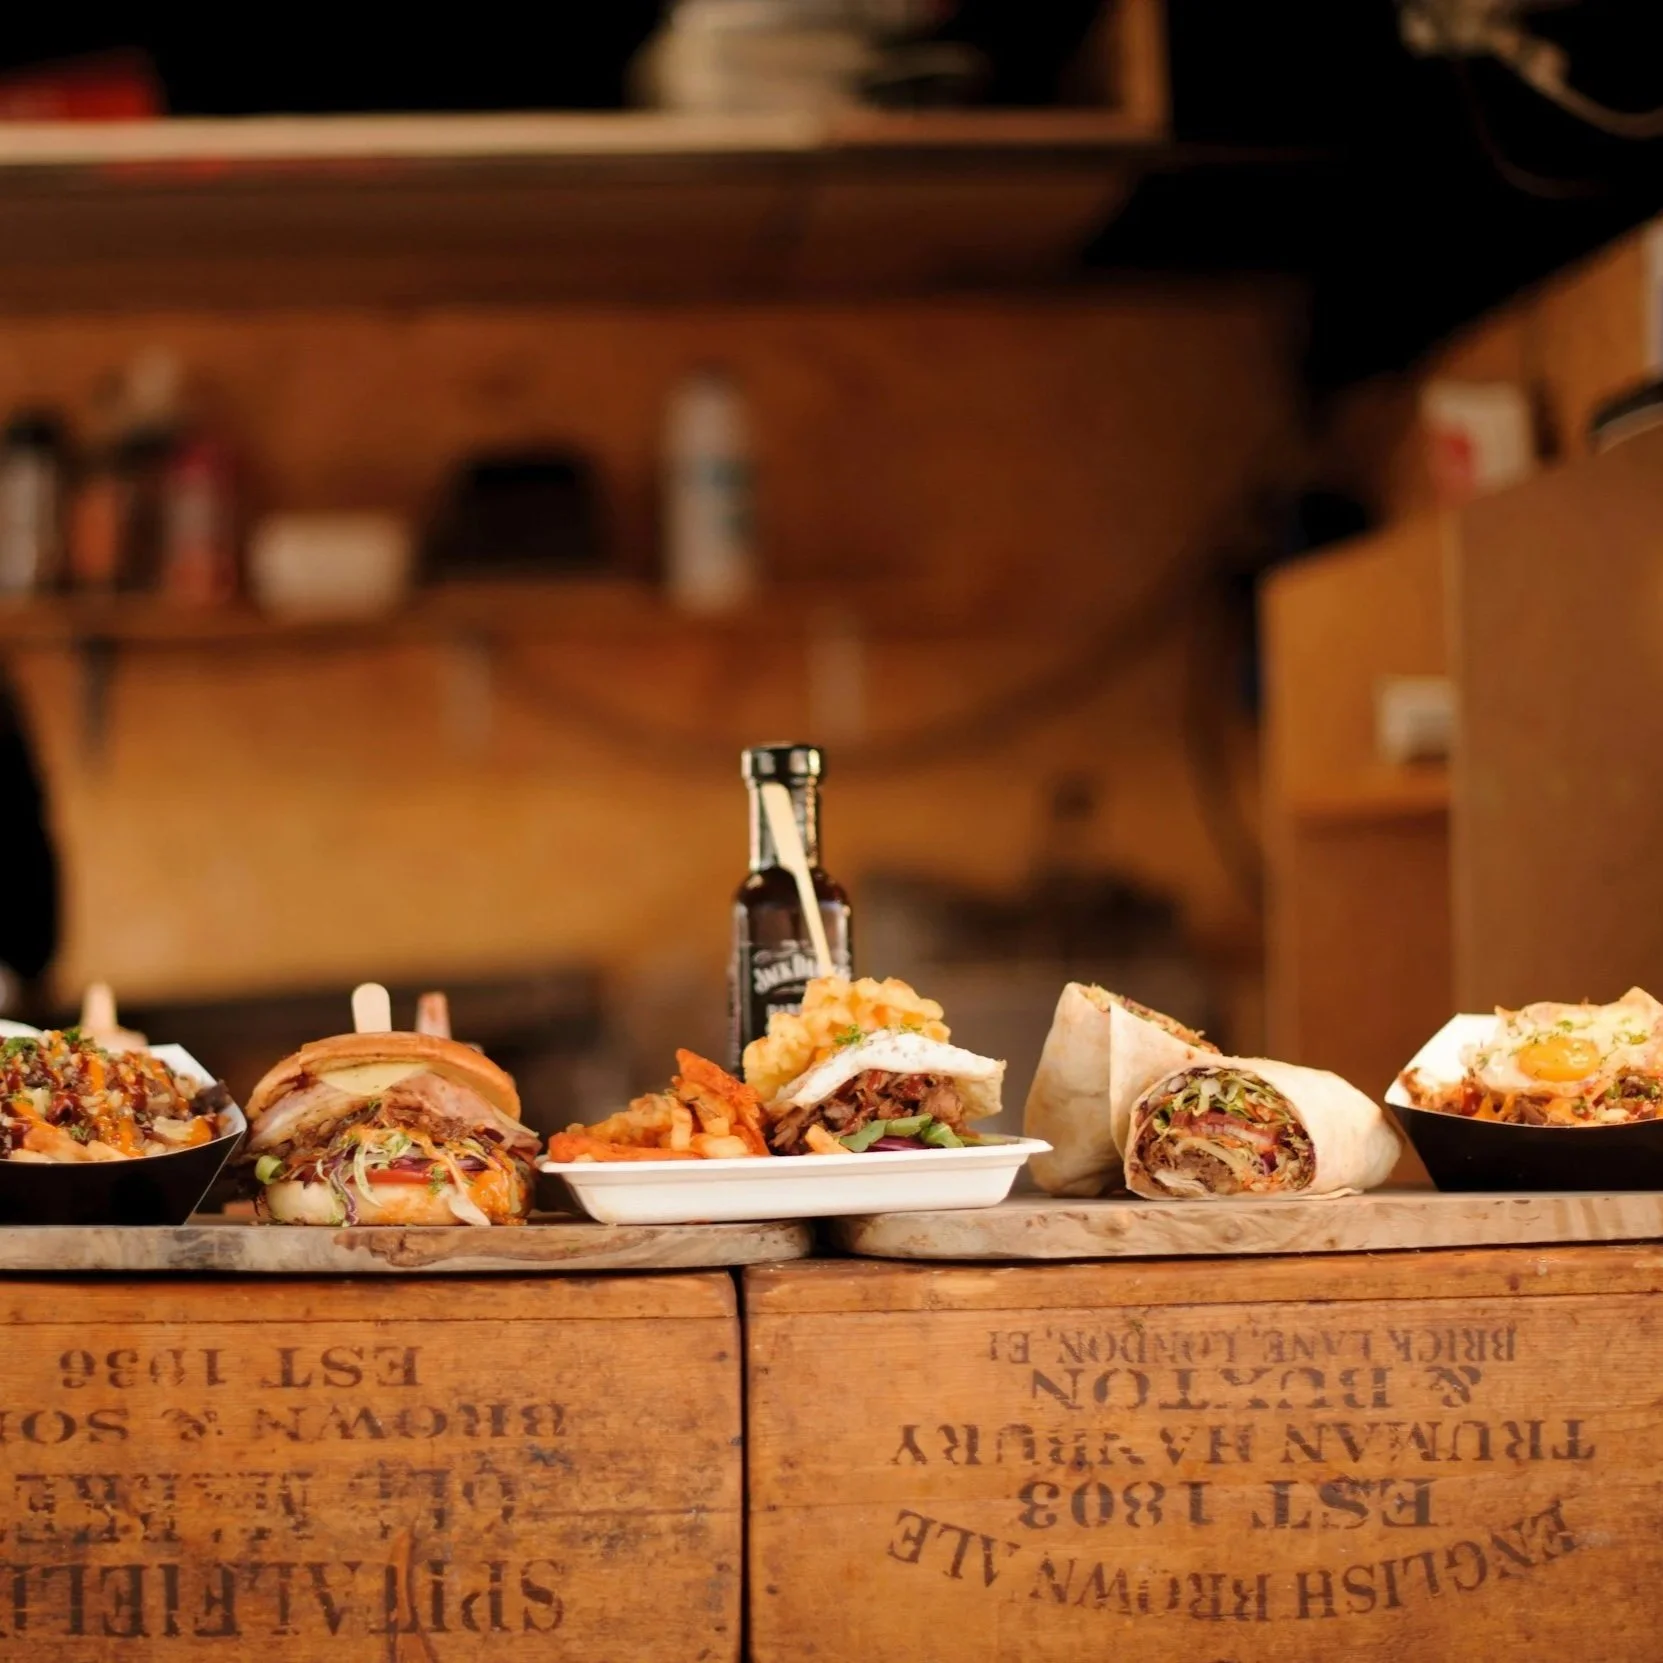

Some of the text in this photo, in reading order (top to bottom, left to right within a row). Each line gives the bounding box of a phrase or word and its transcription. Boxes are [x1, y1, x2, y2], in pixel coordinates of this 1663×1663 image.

[1386, 1325, 1517, 1362] BRICK
[260, 1346, 423, 1388] EST
[1031, 1365, 1482, 1410] & BUXTON
[256, 1401, 570, 1443] BROWN
[1280, 1419, 1596, 1464] TRUMAN
[1017, 1477, 1442, 1530] EST 1803
[886, 1498, 1577, 1622] ENGLISH BROWN ALE
